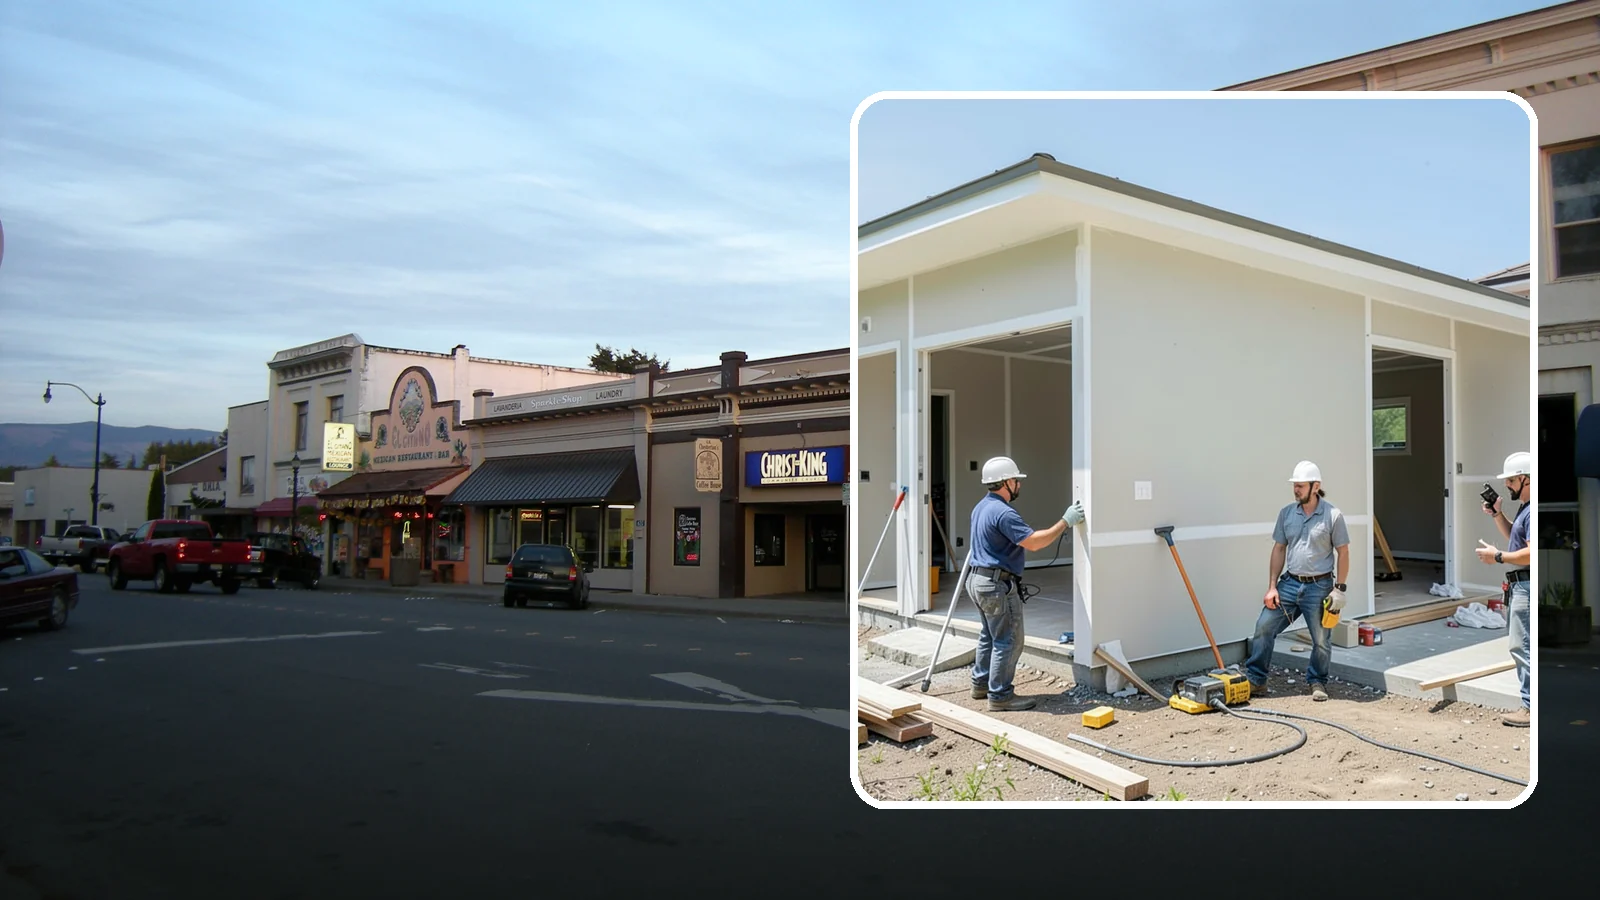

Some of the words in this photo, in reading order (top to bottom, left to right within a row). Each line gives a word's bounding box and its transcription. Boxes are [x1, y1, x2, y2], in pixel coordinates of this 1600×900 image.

[561, 394, 582, 407] Shop
[595, 389, 623, 400] LAUNDRY
[493, 402, 522, 413] LAVANDERIA
[373, 455, 396, 464] MEXICAN
[397, 451, 433, 462] RESTAURANT
[438, 450, 450, 459] BAR
[799, 450, 827, 476] KING
